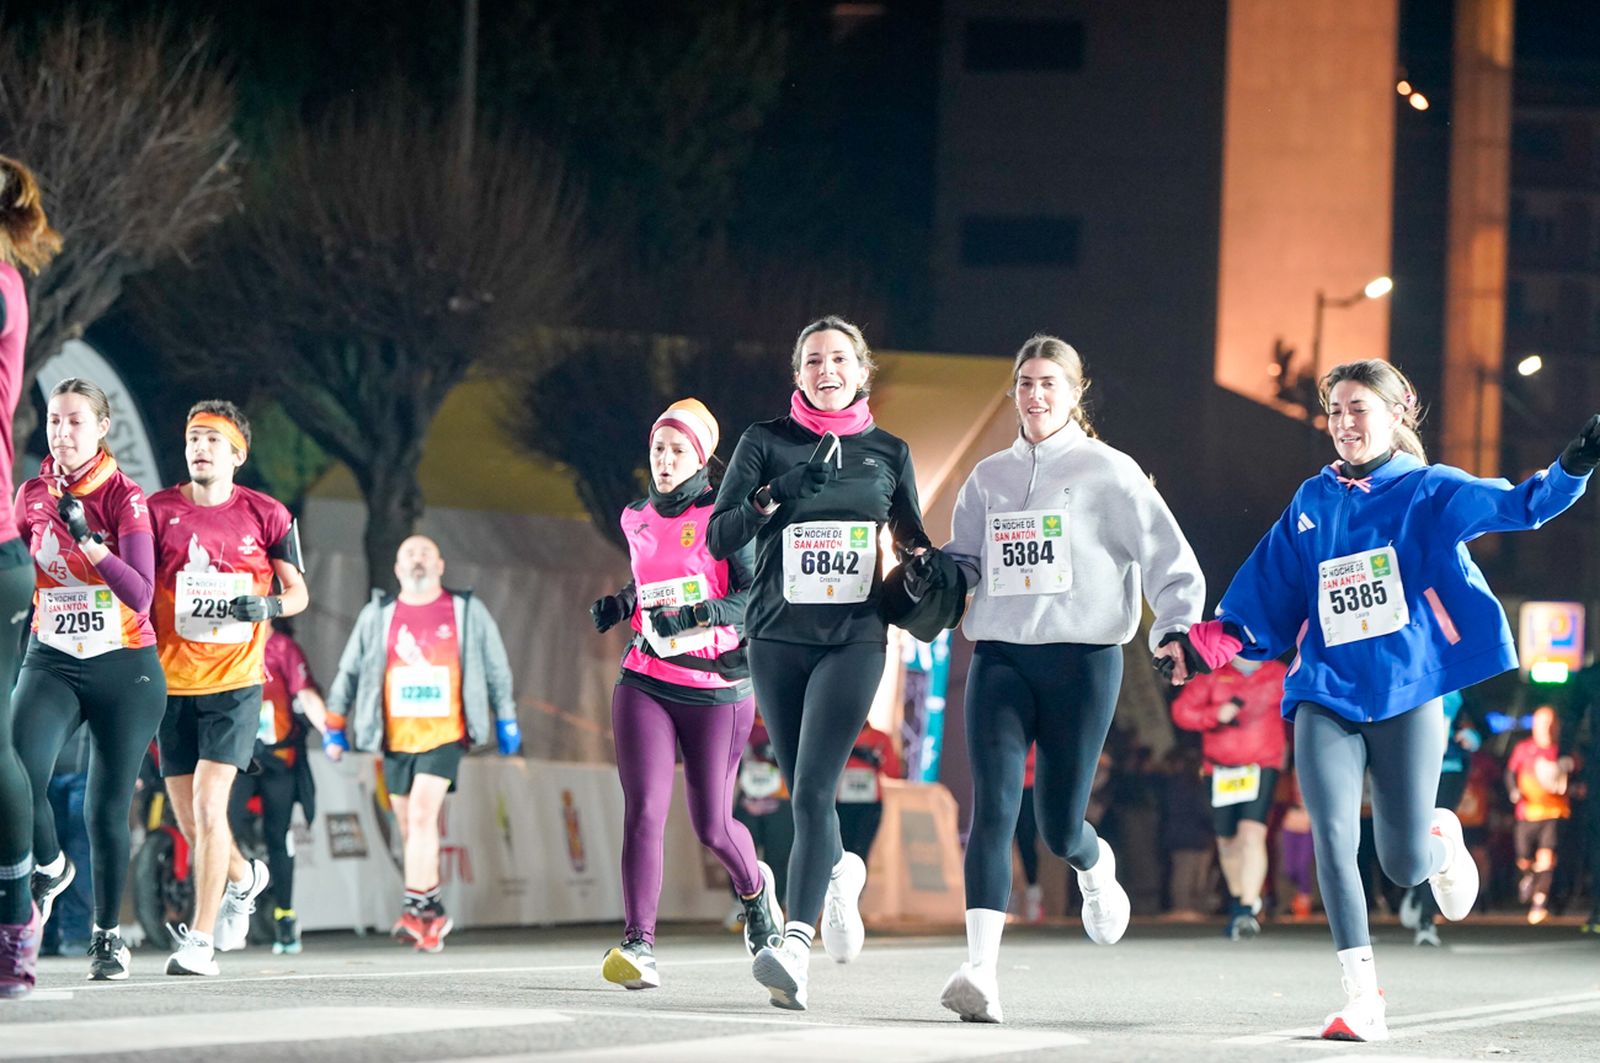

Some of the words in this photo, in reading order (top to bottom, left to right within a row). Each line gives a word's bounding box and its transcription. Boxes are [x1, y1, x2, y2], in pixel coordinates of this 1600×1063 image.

[1002, 521, 1025, 530] NOCHE
[1026, 520, 1035, 529] DE
[804, 530, 831, 538] NOCHE
[832, 530, 842, 538] DE
[994, 532, 1010, 542] SAN
[794, 540, 812, 549] SAN
[1002, 540, 1055, 567] 5384
[801, 550, 859, 575] 6842
[48, 560, 67, 580] 43
[1328, 565, 1355, 577] NOCHE
[1356, 562, 1365, 572] DE
[1323, 581, 1339, 590] SAN
[53, 594, 78, 603] NOCHE
[78, 593, 87, 602] DE
[186, 589, 201, 597] SAN
[647, 590, 665, 599] NOCHE
[665, 588, 675, 597] DE
[1329, 580, 1388, 615] 5385
[48, 604, 61, 613] SAN
[55, 611, 105, 635] 2295
